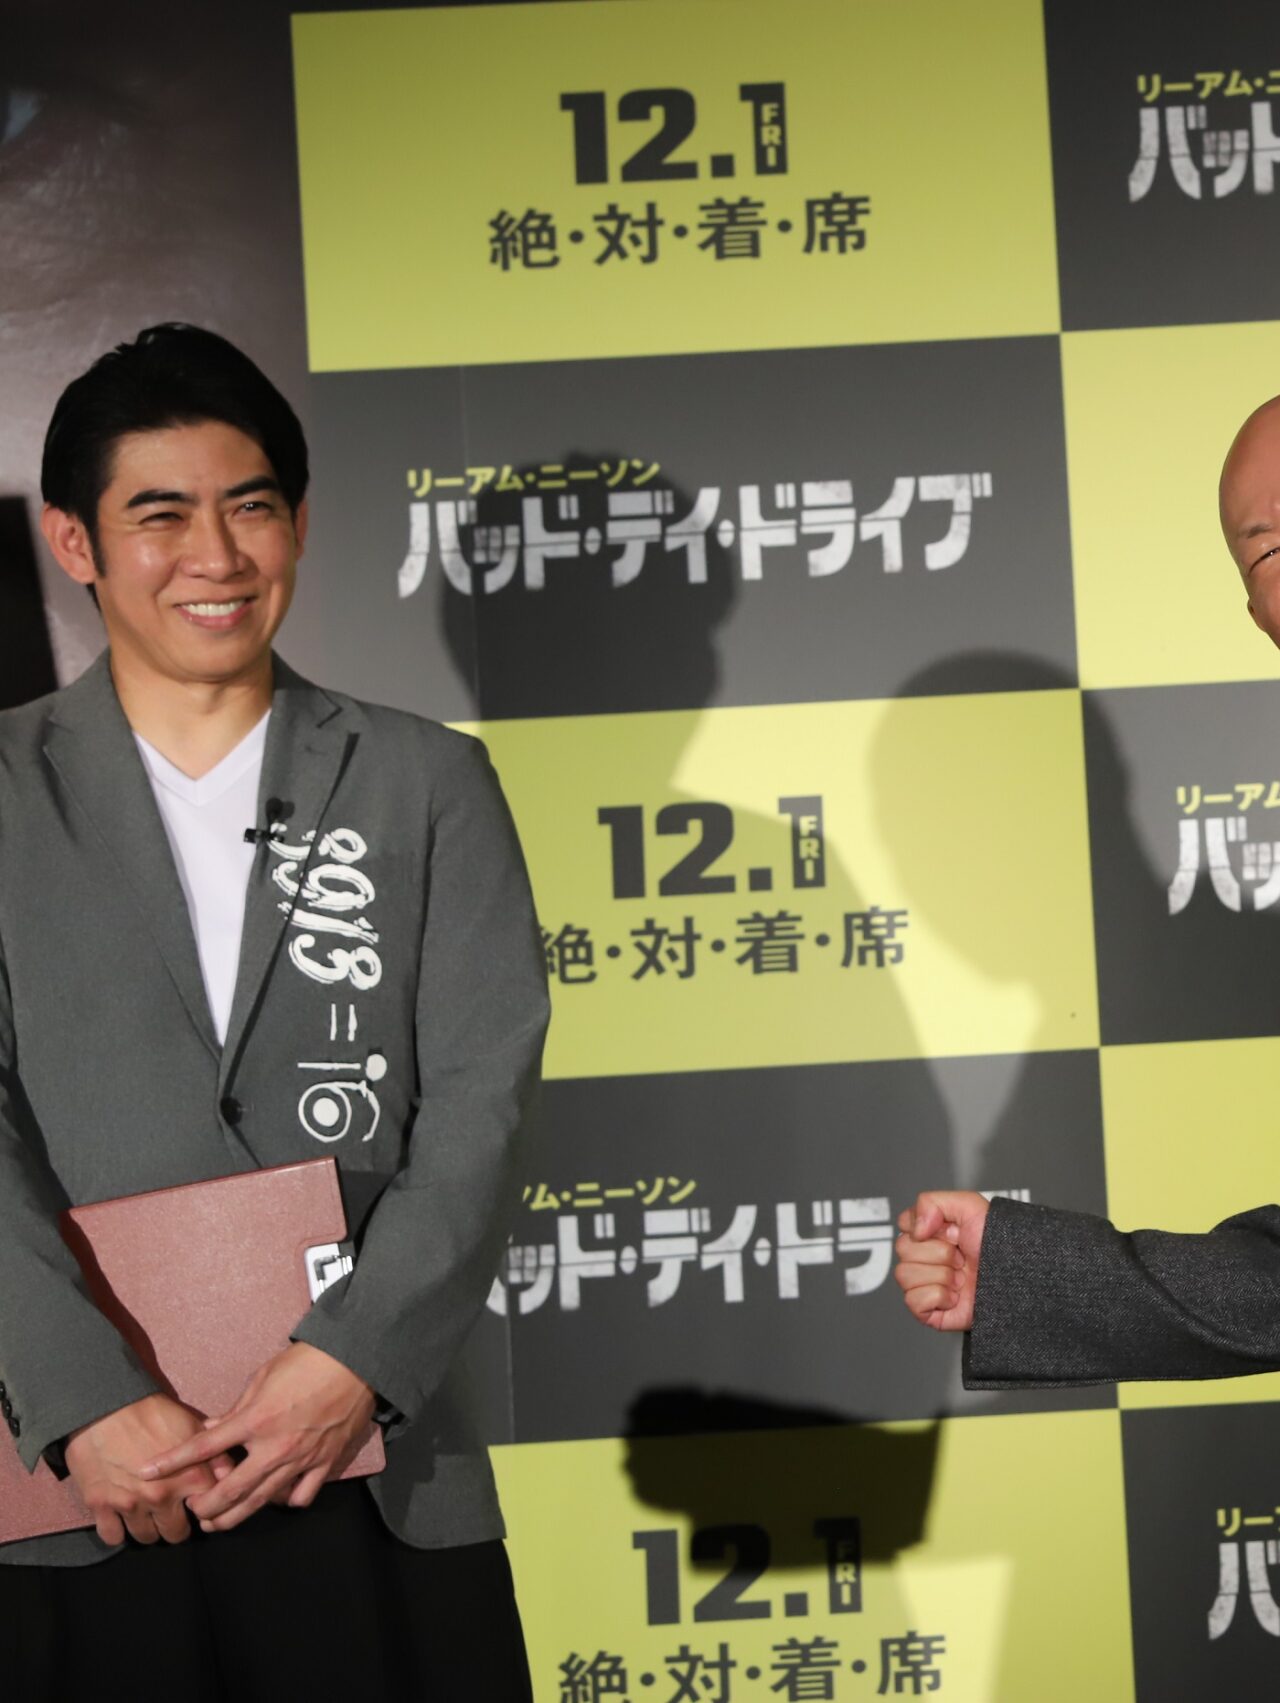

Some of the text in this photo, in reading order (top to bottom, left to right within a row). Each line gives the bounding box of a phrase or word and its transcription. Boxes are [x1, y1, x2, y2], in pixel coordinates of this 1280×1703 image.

[560, 82, 788, 185] 12.1
[761, 103, 781, 167] FRI
[488, 192, 872, 272] 絶・対・着・席
[407, 459, 660, 498] リーアム・ニーソン
[398, 473, 992, 599] バッド・デイ・ドライブ
[597, 795, 826, 900] 12.1
[799, 816, 820, 881] FRI
[522, 1176, 697, 1212] ム・ニーソン
[632, 1516, 863, 1627] 12.1
